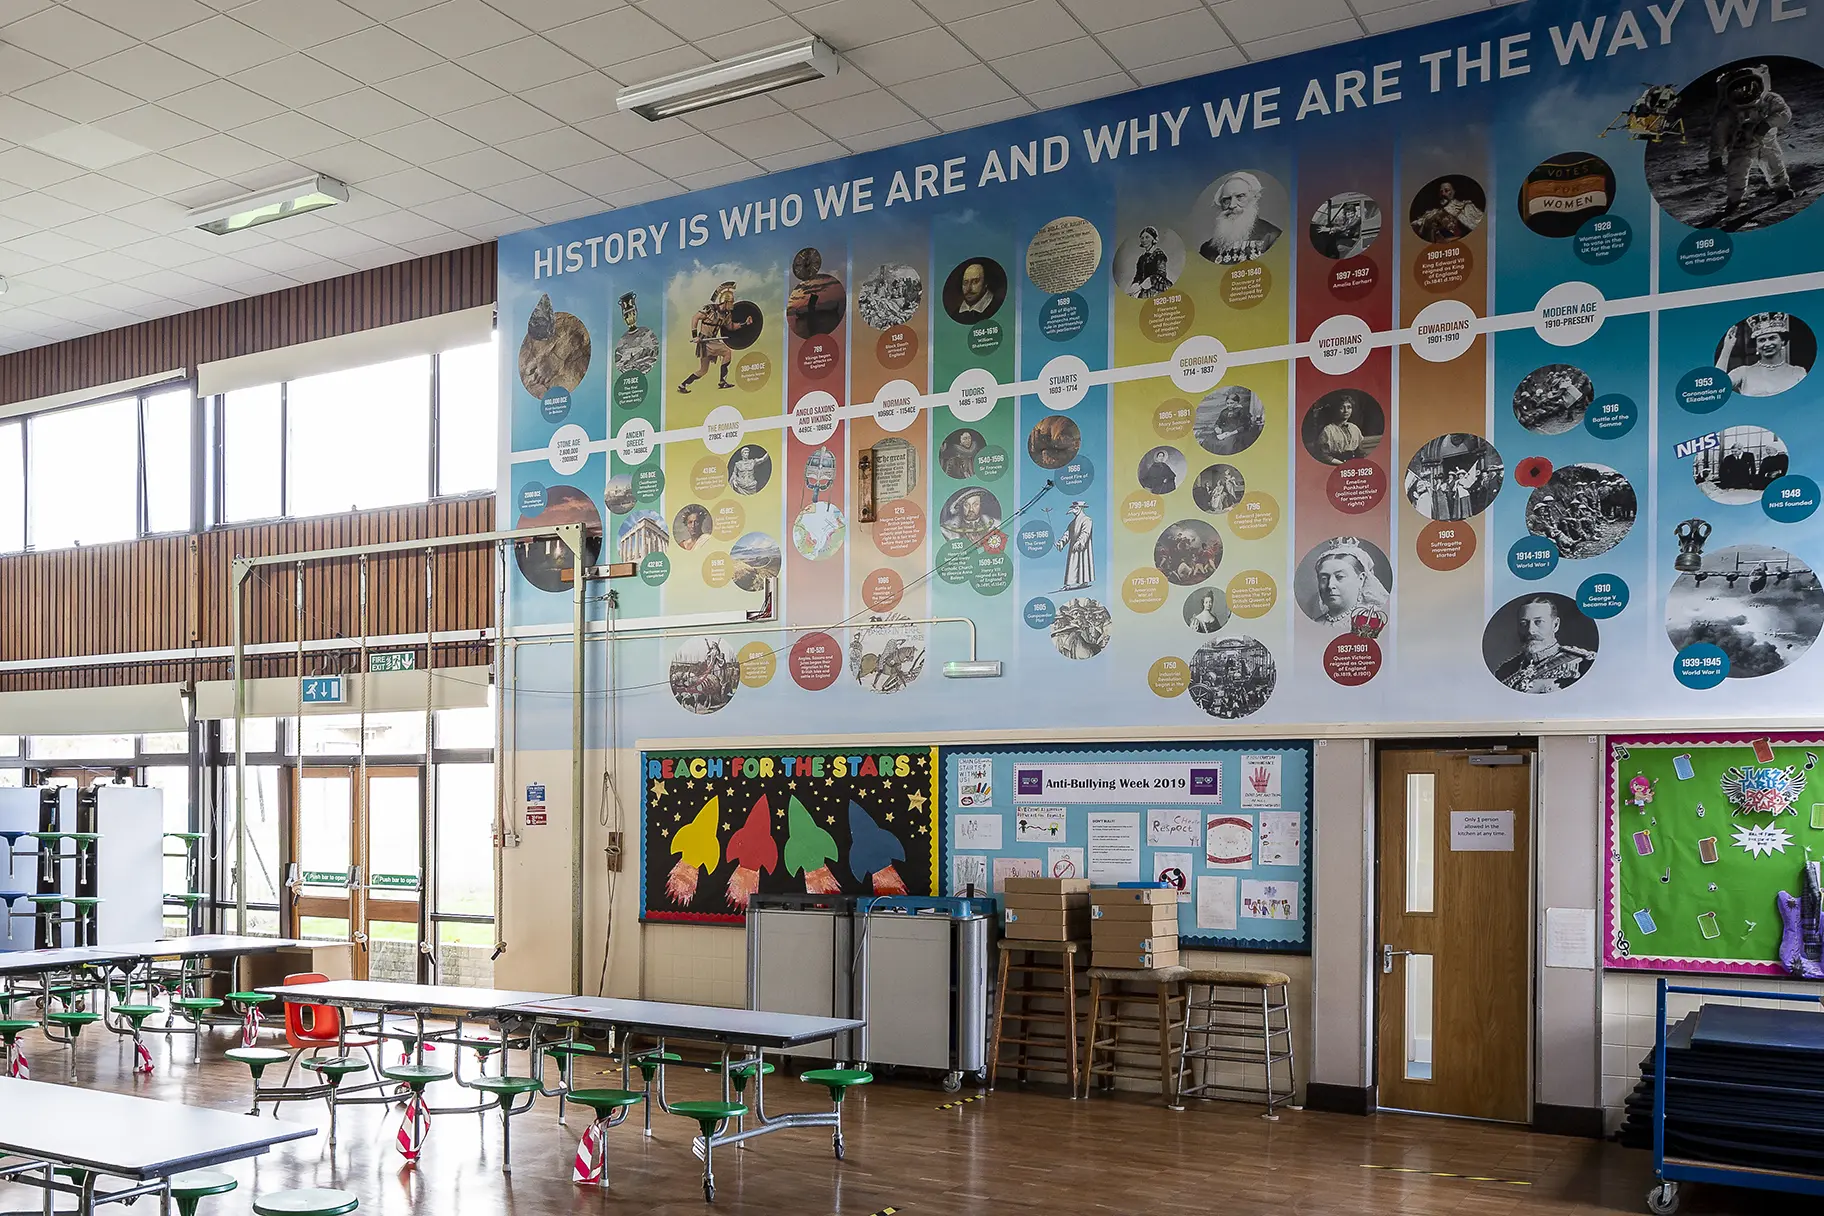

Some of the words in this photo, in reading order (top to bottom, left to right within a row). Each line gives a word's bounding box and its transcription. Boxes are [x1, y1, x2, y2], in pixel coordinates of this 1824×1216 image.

[534, 221, 669, 279] HISTORY
[679, 218, 708, 249] IS
[719, 194, 802, 240] WHO
[814, 177, 874, 220] WE
[885, 157, 966, 208] ARE
[978, 135, 1069, 187] AND
[1083, 106, 1191, 163] WHY
[1203, 87, 1281, 138] WE
[1296, 61, 1402, 120] ARE
[1419, 32, 1531, 93] THE
[1549, 0, 1685, 66] WAY
[1548, 165, 1588, 177] VOTES
[1543, 196, 1593, 208] WOMEN
[1594, 222, 1611, 231] 1928
[1602, 230, 1626, 238] allowed
[1696, 239, 1714, 249] 1969
[1427, 248, 1460, 260] 1901-1910
[1680, 252, 1706, 261] Humans
[1707, 248, 1730, 257] landed
[1435, 259, 1457, 267] Edward
[1336, 271, 1350, 280] 1897
[1422, 267, 1443, 275] reigned
[1435, 270, 1458, 279] England
[1352, 278, 1372, 286] Earhart
[1543, 304, 1578, 318] MODERN
[1580, 302, 1597, 312] AGE
[1544, 314, 1594, 328] 1910-PRESENT
[1418, 320, 1469, 335] EDWARDIANS
[1318, 334, 1362, 348] VICTORIANS
[1428, 332, 1460, 344] 1901-1910
[1323, 349, 1337, 358] 1837
[1343, 347, 1358, 355] 1901
[1180, 354, 1218, 368] GEORGIANS
[1183, 368, 1196, 376] 1714
[1201, 366, 1214, 374] 1837
[1049, 374, 1078, 385] STUARTS
[1695, 377, 1713, 388] 1953
[961, 387, 985, 397] TUDORS
[1049, 386, 1061, 394] 1603
[1066, 384, 1078, 392] 1714
[1682, 389, 1717, 398] Coronation
[882, 397, 911, 408] NORMANS
[1686, 395, 1715, 403] Elizabeth
[796, 407, 814, 417] ANGLO
[815, 405, 835, 415] SAXONS
[1602, 404, 1619, 413] 1916
[799, 416, 810, 425] AND
[811, 414, 832, 423] VIKINGS
[708, 424, 717, 433] THE
[718, 422, 739, 431] ROMANS
[626, 430, 645, 439] ANCIENT
[557, 440, 572, 448] STONE
[626, 439, 644, 447] GREECE
[1677, 433, 1717, 458] NHS
[1340, 468, 1372, 478] 1858-1928
[1781, 489, 1801, 498] 1948
[1785, 499, 1813, 507] founded
[1438, 530, 1455, 539] 1903
[1431, 540, 1462, 548] Suffragette
[1516, 550, 1550, 560] 1914-1918
[1594, 584, 1610, 593] 1910
[1337, 644, 1368, 653] 1837-1901
[1682, 657, 1721, 667] 1939-1945
[649, 758, 723, 779] REACH
[732, 757, 774, 778] FOR
[781, 756, 825, 778] THE
[832, 754, 910, 778] STARS
[1741, 766, 1780, 780] TIMES
[1046, 778, 1116, 790] Anti-Bullying
[1120, 778, 1150, 788] Week
[1154, 778, 1186, 788] 2019
[1740, 779, 1786, 791] TABLES
[1746, 789, 1784, 801] ROCK
[1743, 799, 1788, 815] STARS
[1152, 820, 1193, 835] Respect
